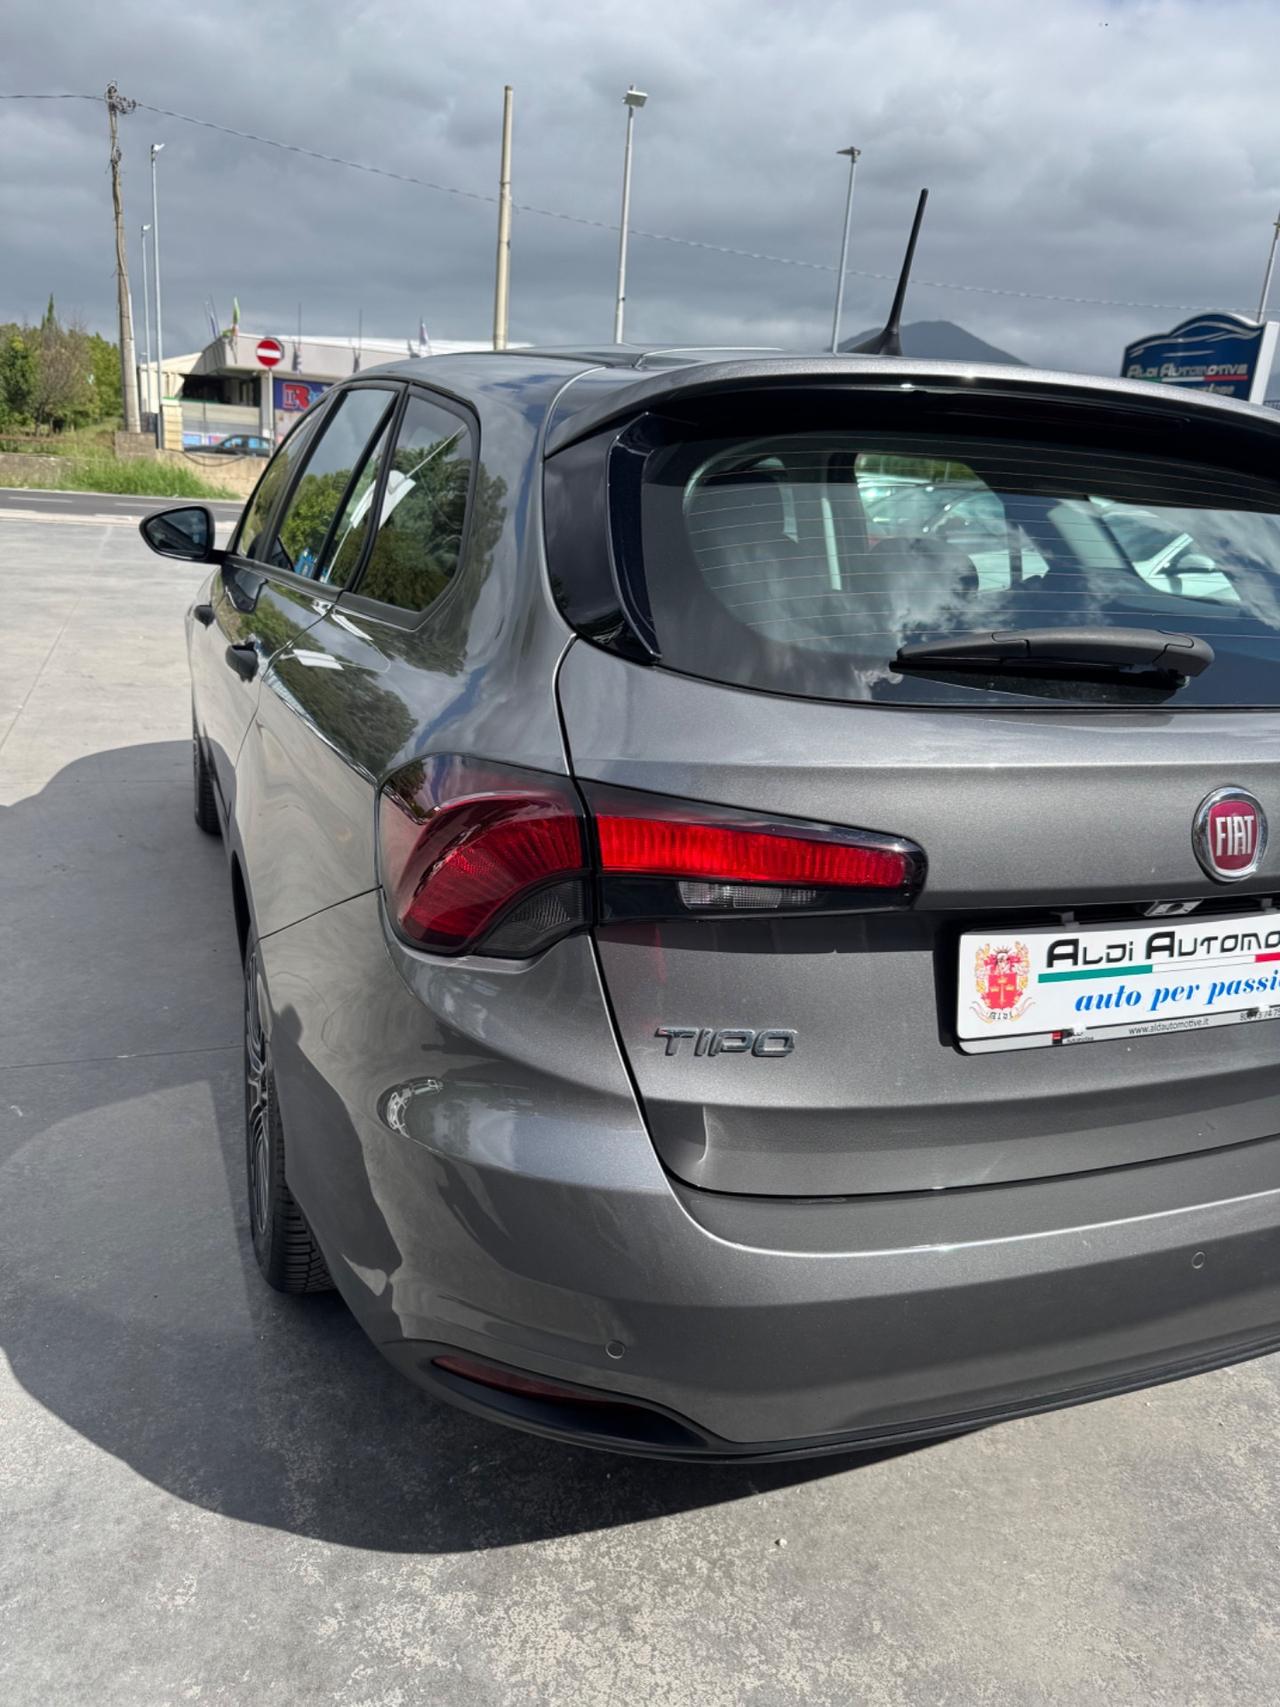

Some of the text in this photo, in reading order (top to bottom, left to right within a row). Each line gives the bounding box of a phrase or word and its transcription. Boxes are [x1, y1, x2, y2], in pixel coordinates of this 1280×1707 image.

[1215, 815, 1254, 857] FIAT
[1074, 969, 1280, 1012] auto per passi
[654, 1027, 799, 1057] TIPO
